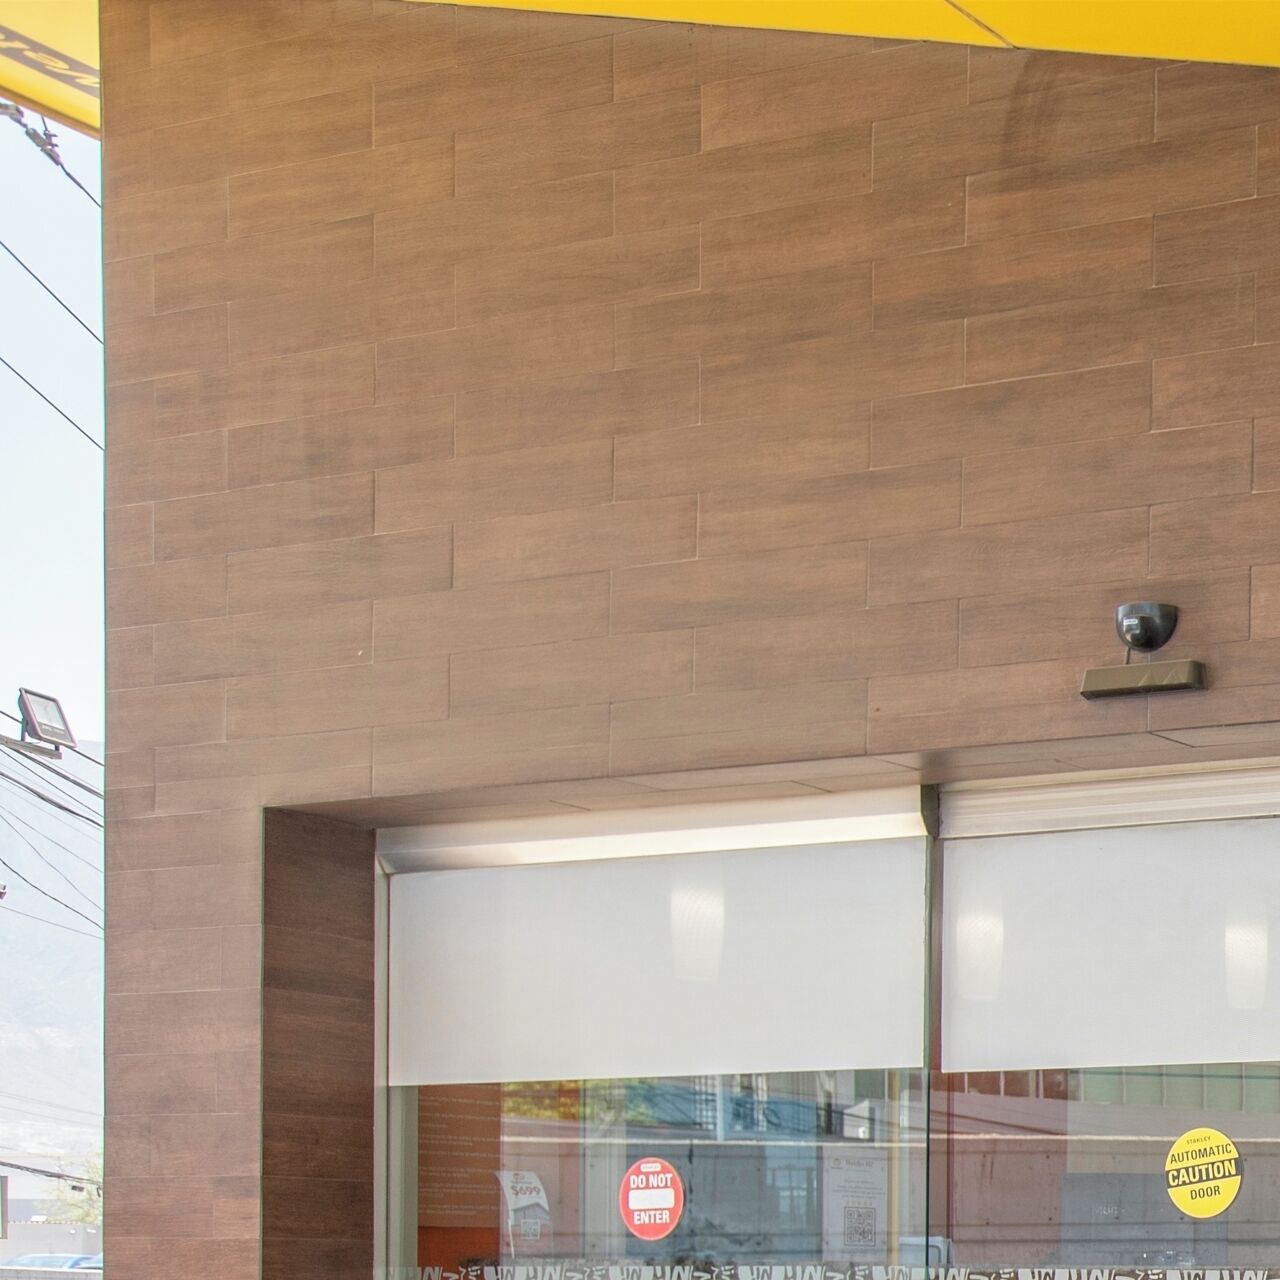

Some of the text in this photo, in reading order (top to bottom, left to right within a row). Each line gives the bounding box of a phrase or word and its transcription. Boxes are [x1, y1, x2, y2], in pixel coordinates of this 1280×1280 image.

[1170, 1143, 1232, 1164] AUTOMATIC
[1168, 1159, 1236, 1186] CAUTION
[630, 1173, 673, 1188] DO NOT
[1190, 1185, 1221, 1200] DOOR
[633, 1210, 670, 1224] ENTER
